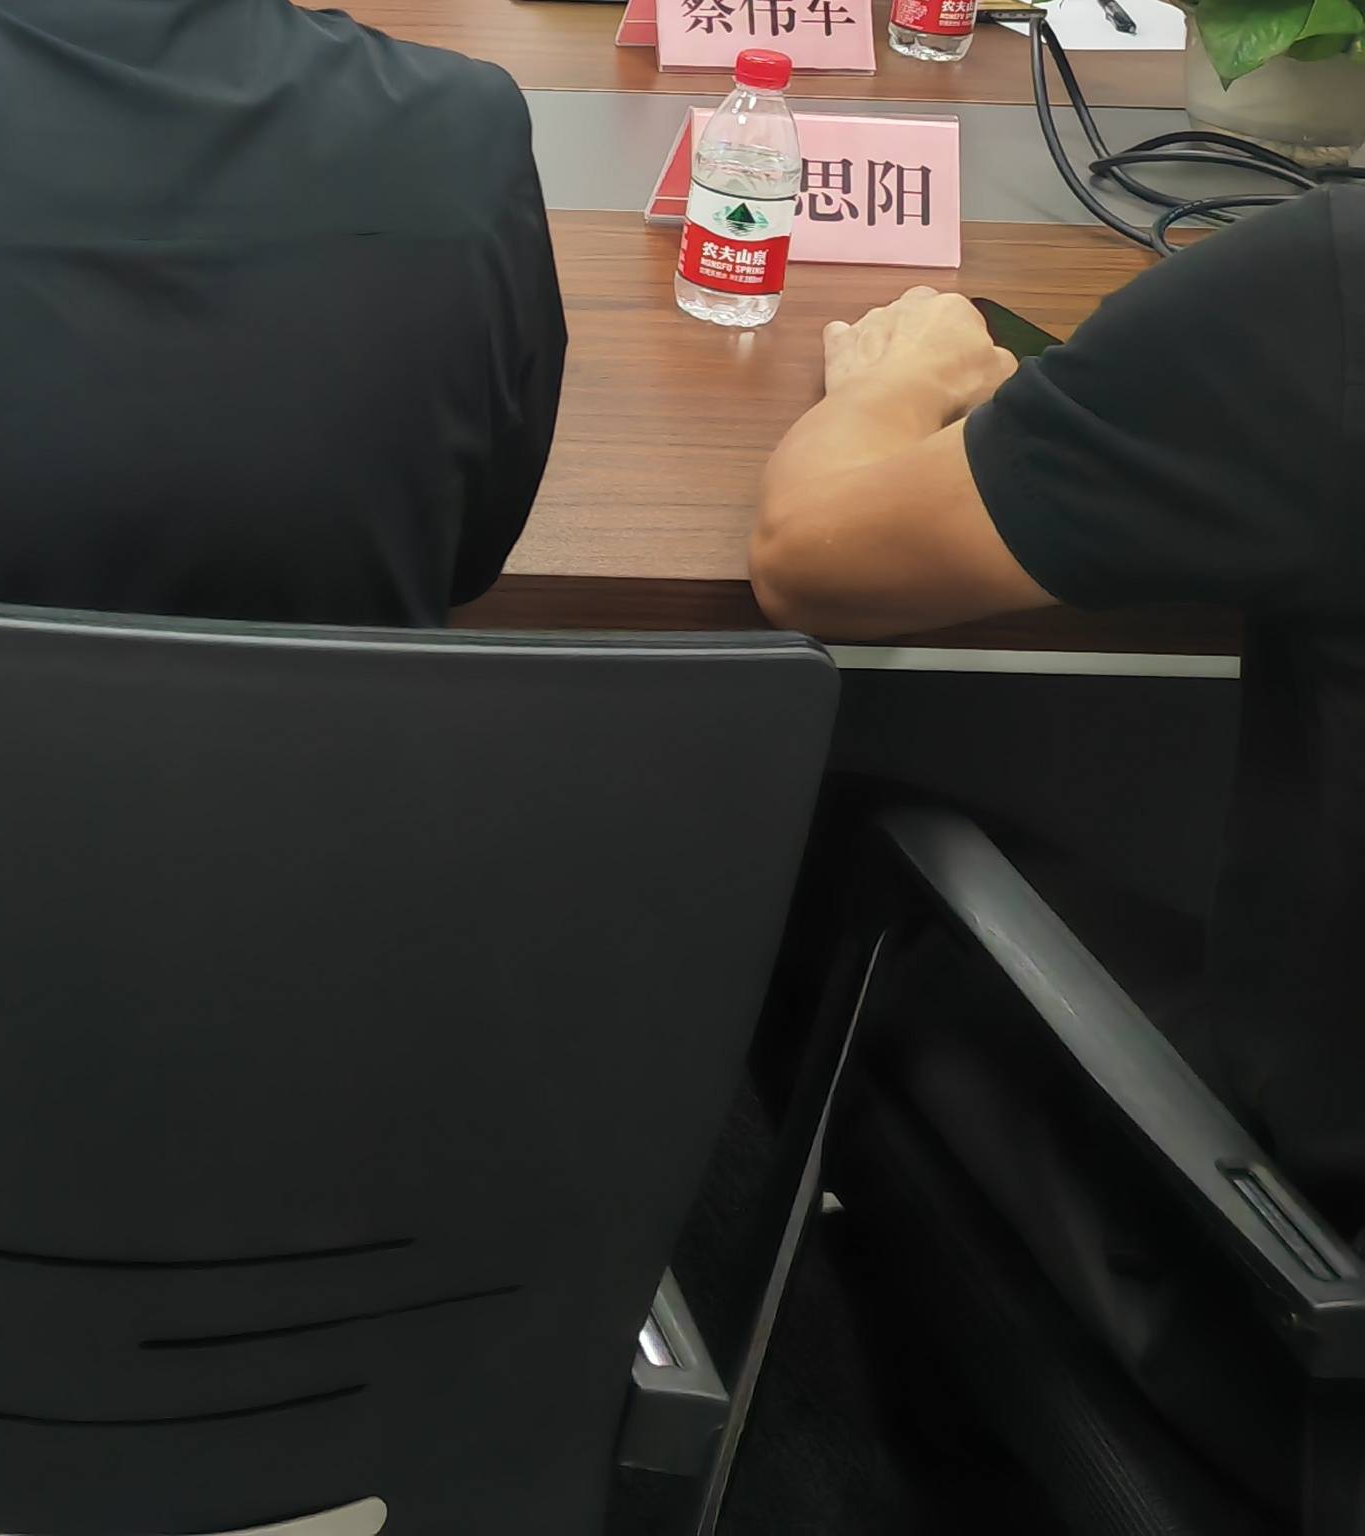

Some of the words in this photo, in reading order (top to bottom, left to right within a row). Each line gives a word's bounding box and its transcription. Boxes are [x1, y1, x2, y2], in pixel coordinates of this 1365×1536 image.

[942, 0, 974, 12] 农夫山
[795, 158, 933, 227] 思阳
[702, 241, 769, 266] 农夫山泉
